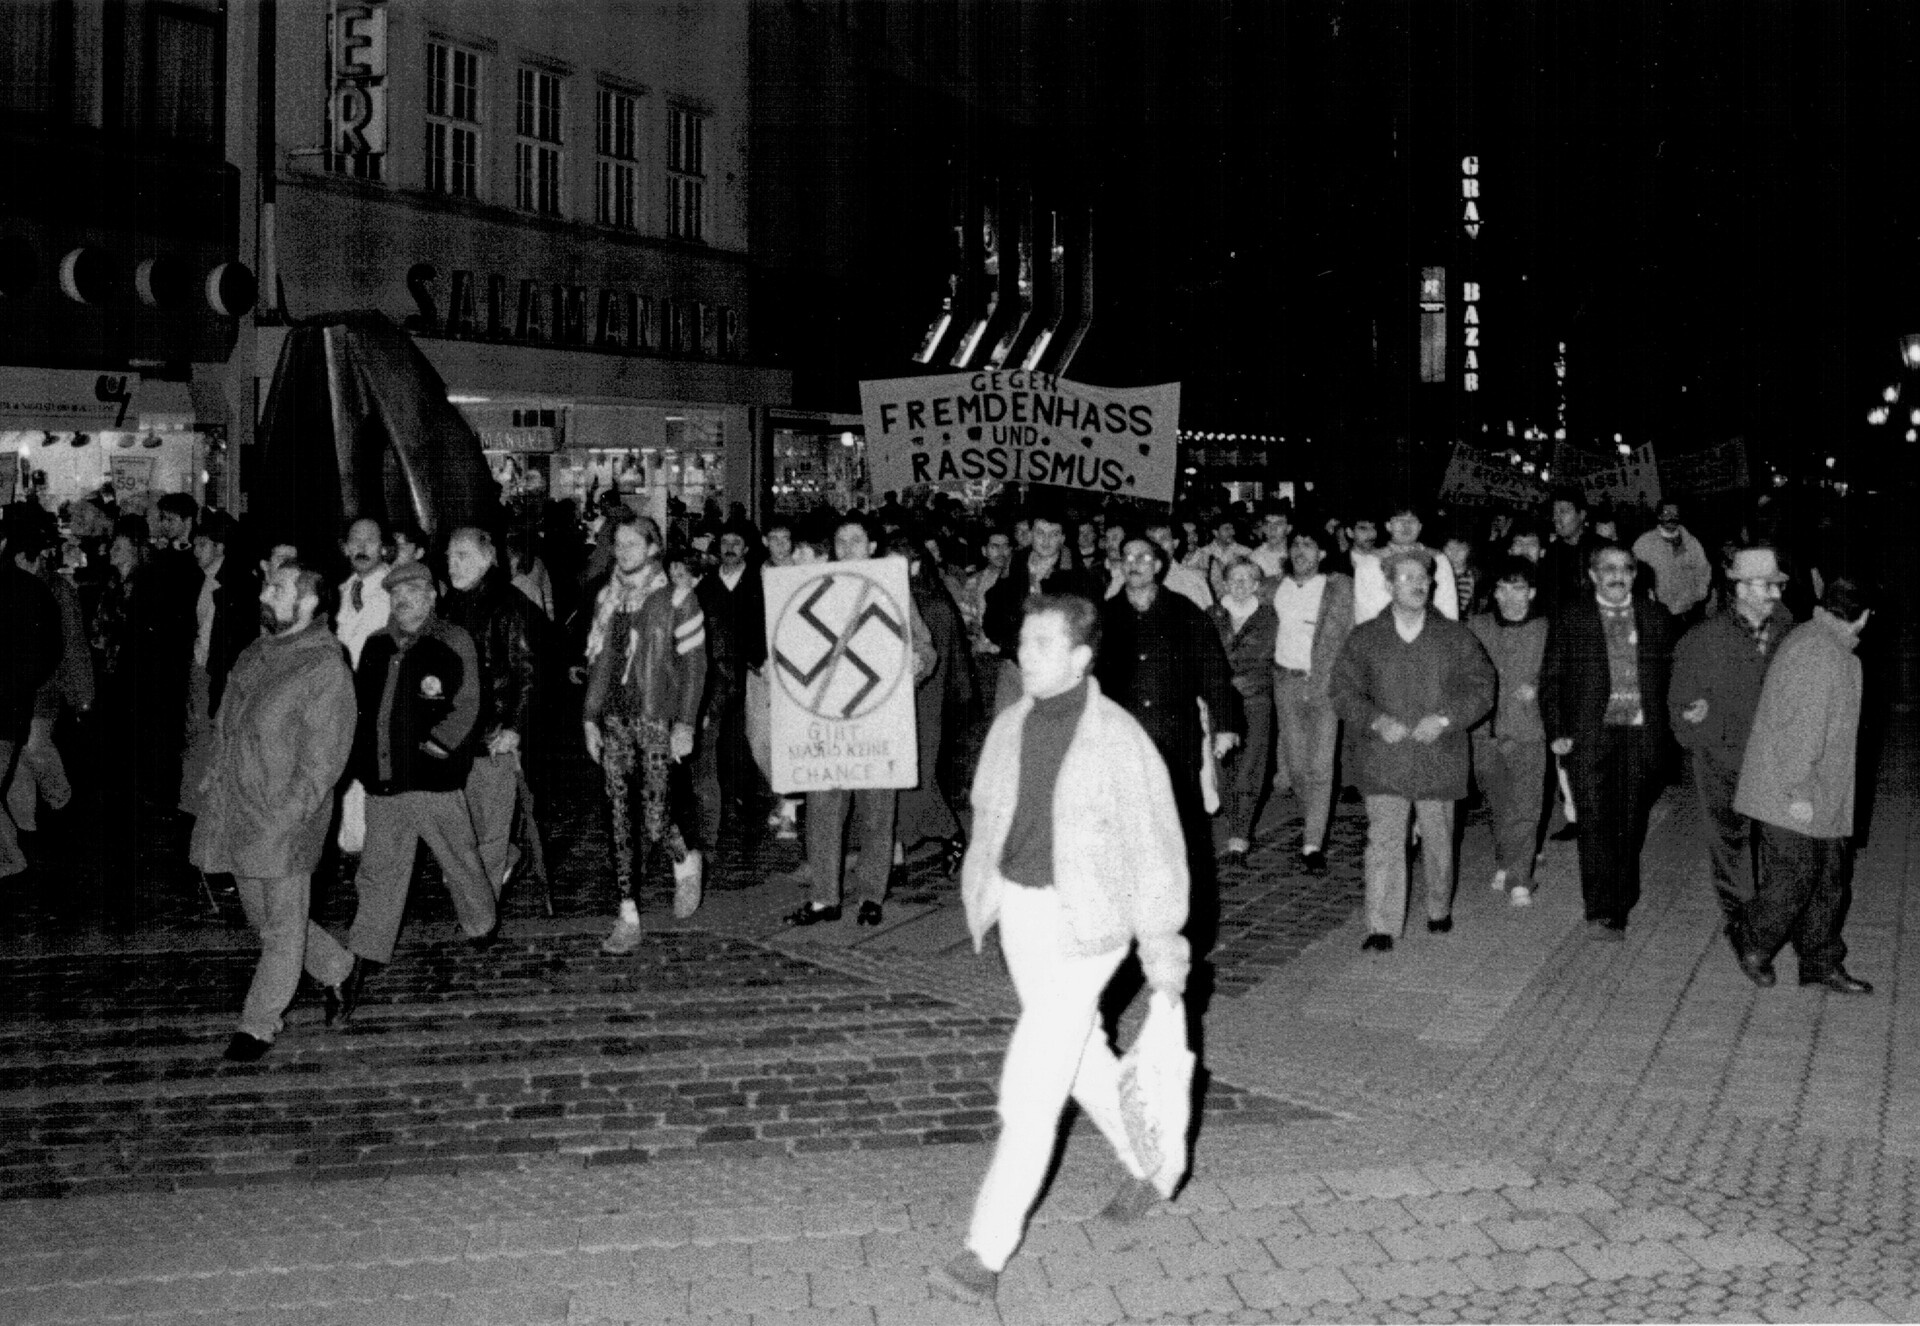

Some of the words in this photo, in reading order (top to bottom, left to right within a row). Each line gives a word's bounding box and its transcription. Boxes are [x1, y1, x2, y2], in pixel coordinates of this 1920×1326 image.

[405, 263, 739, 355] SALAMANDER
[1463, 281, 1480, 392] BAZAR
[971, 370, 1058, 393] GEGEN
[880, 392, 1152, 437] FREMDENHASS
[992, 426, 1039, 447] UND
